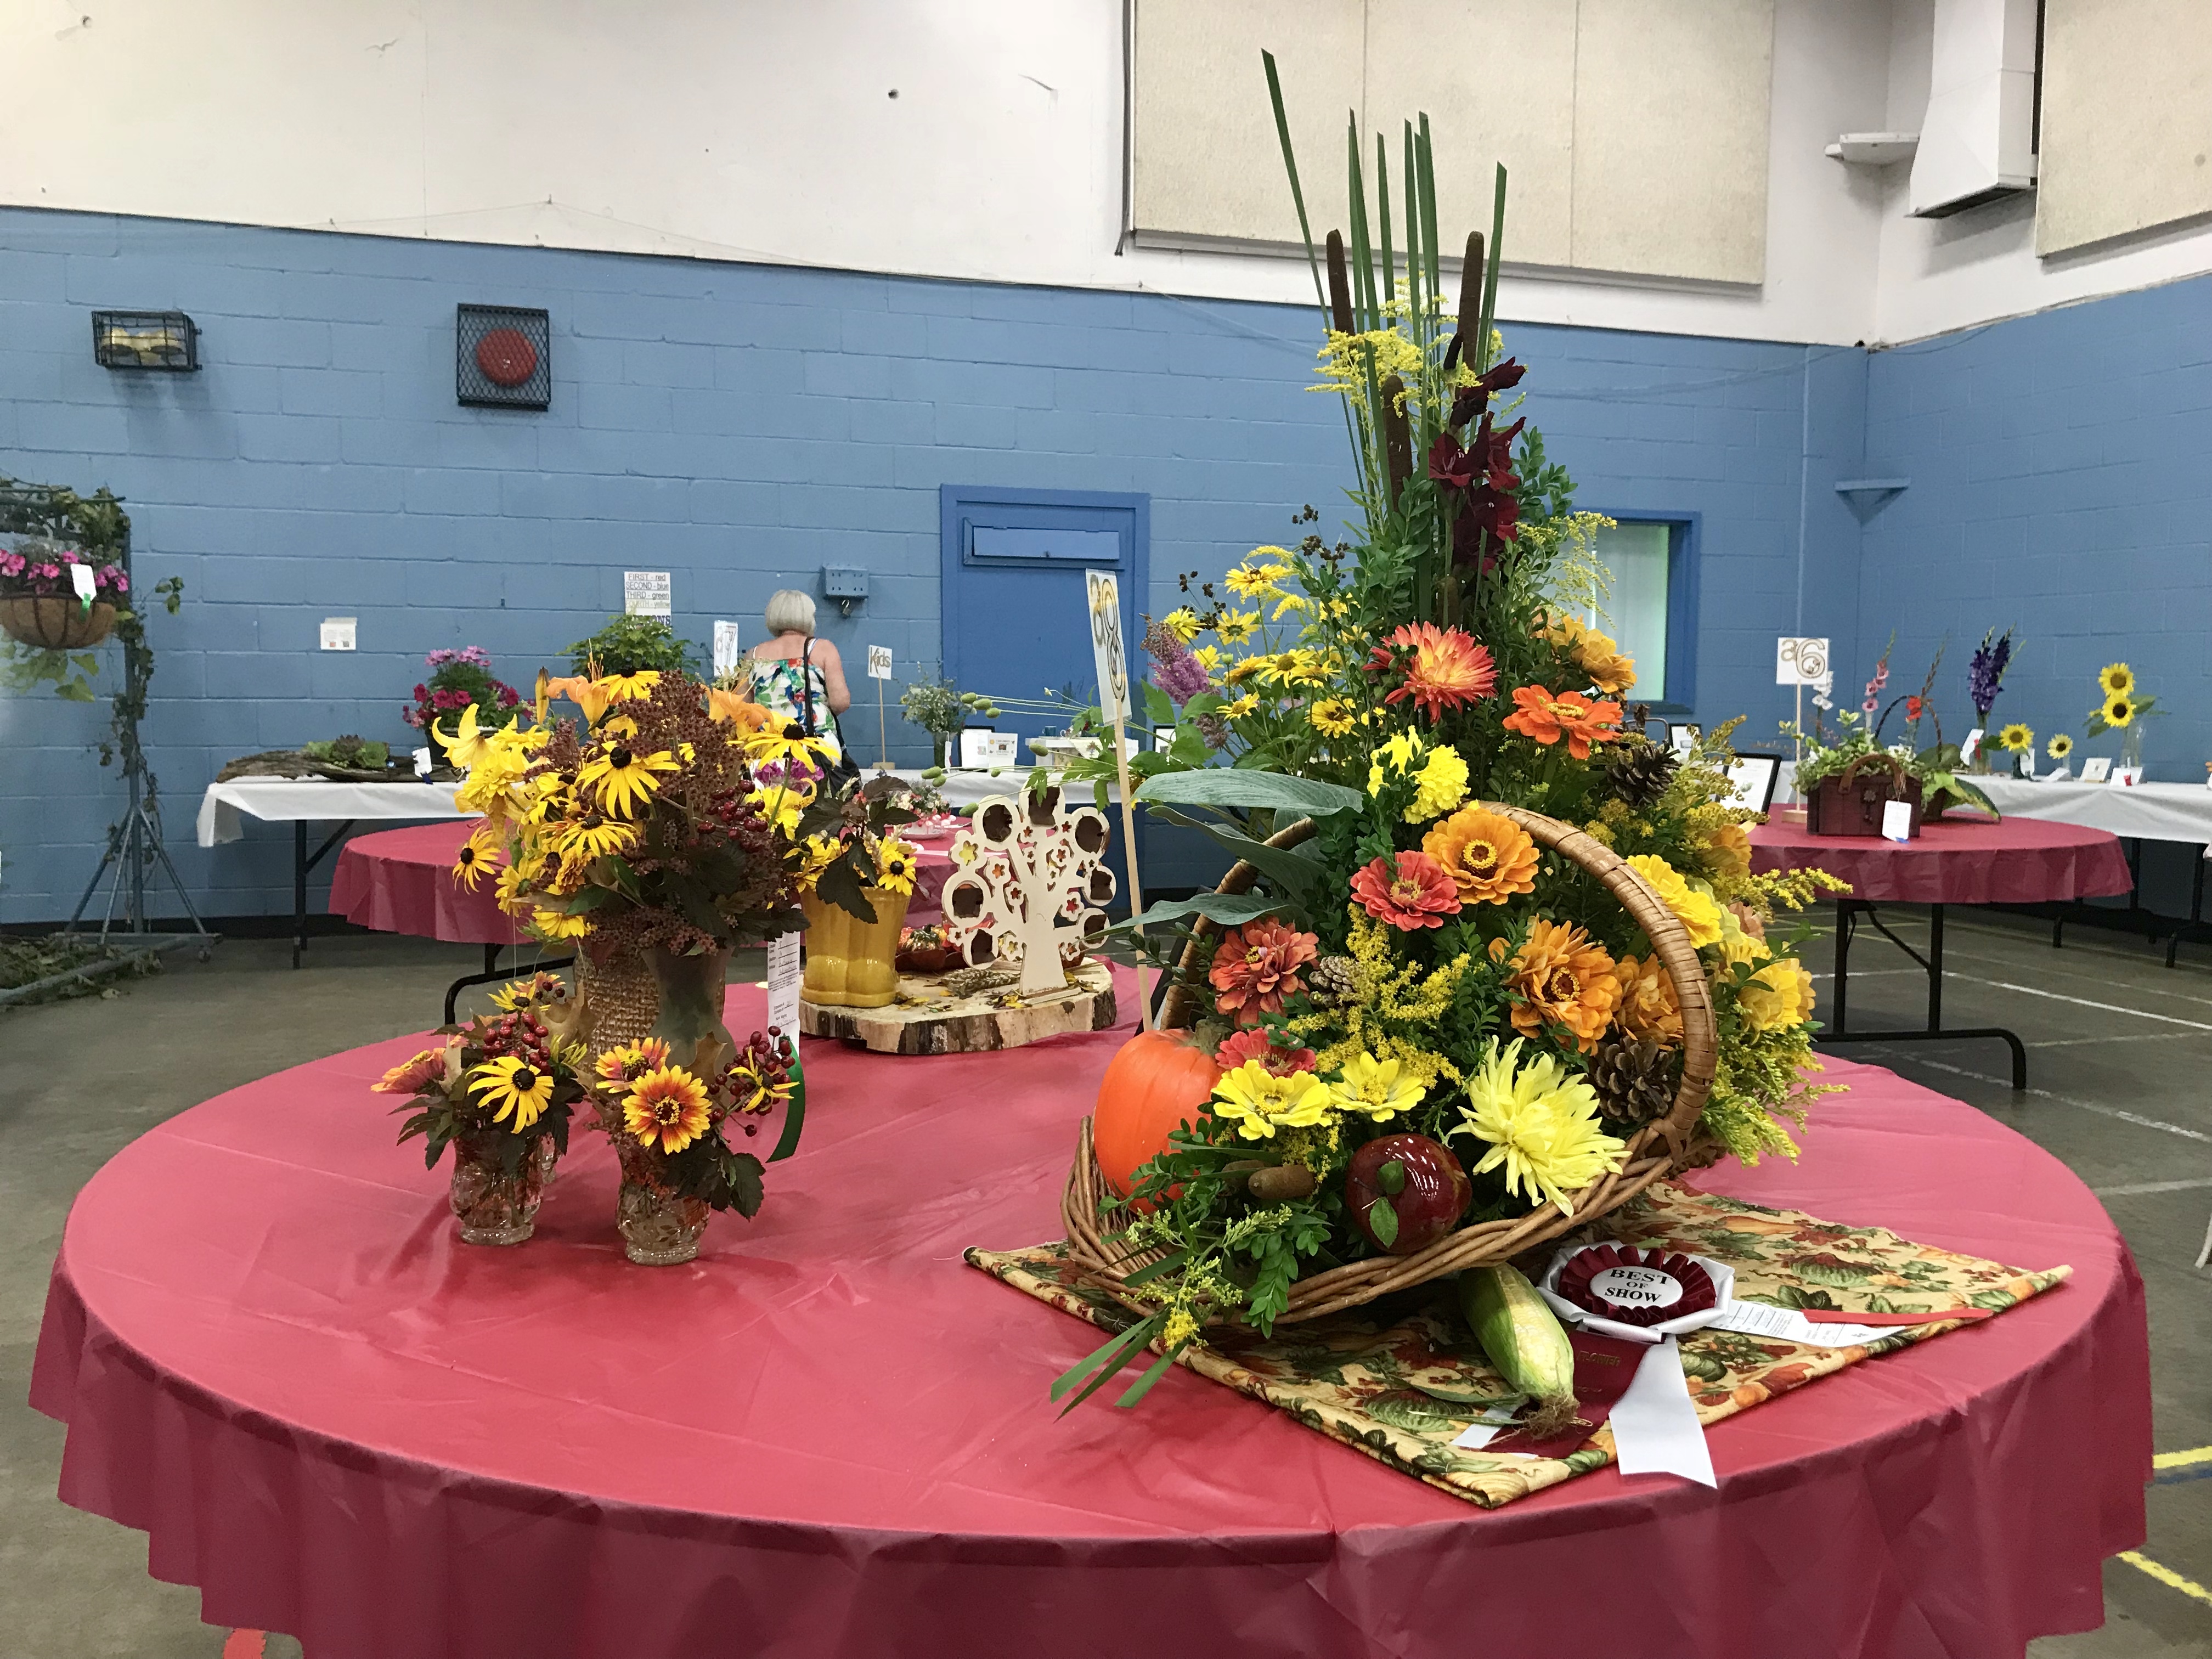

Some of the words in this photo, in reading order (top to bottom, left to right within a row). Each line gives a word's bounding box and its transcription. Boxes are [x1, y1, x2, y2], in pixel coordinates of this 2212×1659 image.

[625, 582, 652, 590] SECOND
[657, 582, 669, 591] blue
[626, 591, 646, 599] THIRD
[870, 646, 891, 674] Kids
[1610, 1269, 1673, 1285] BEST
[1604, 1287, 1662, 1302] SHOW
